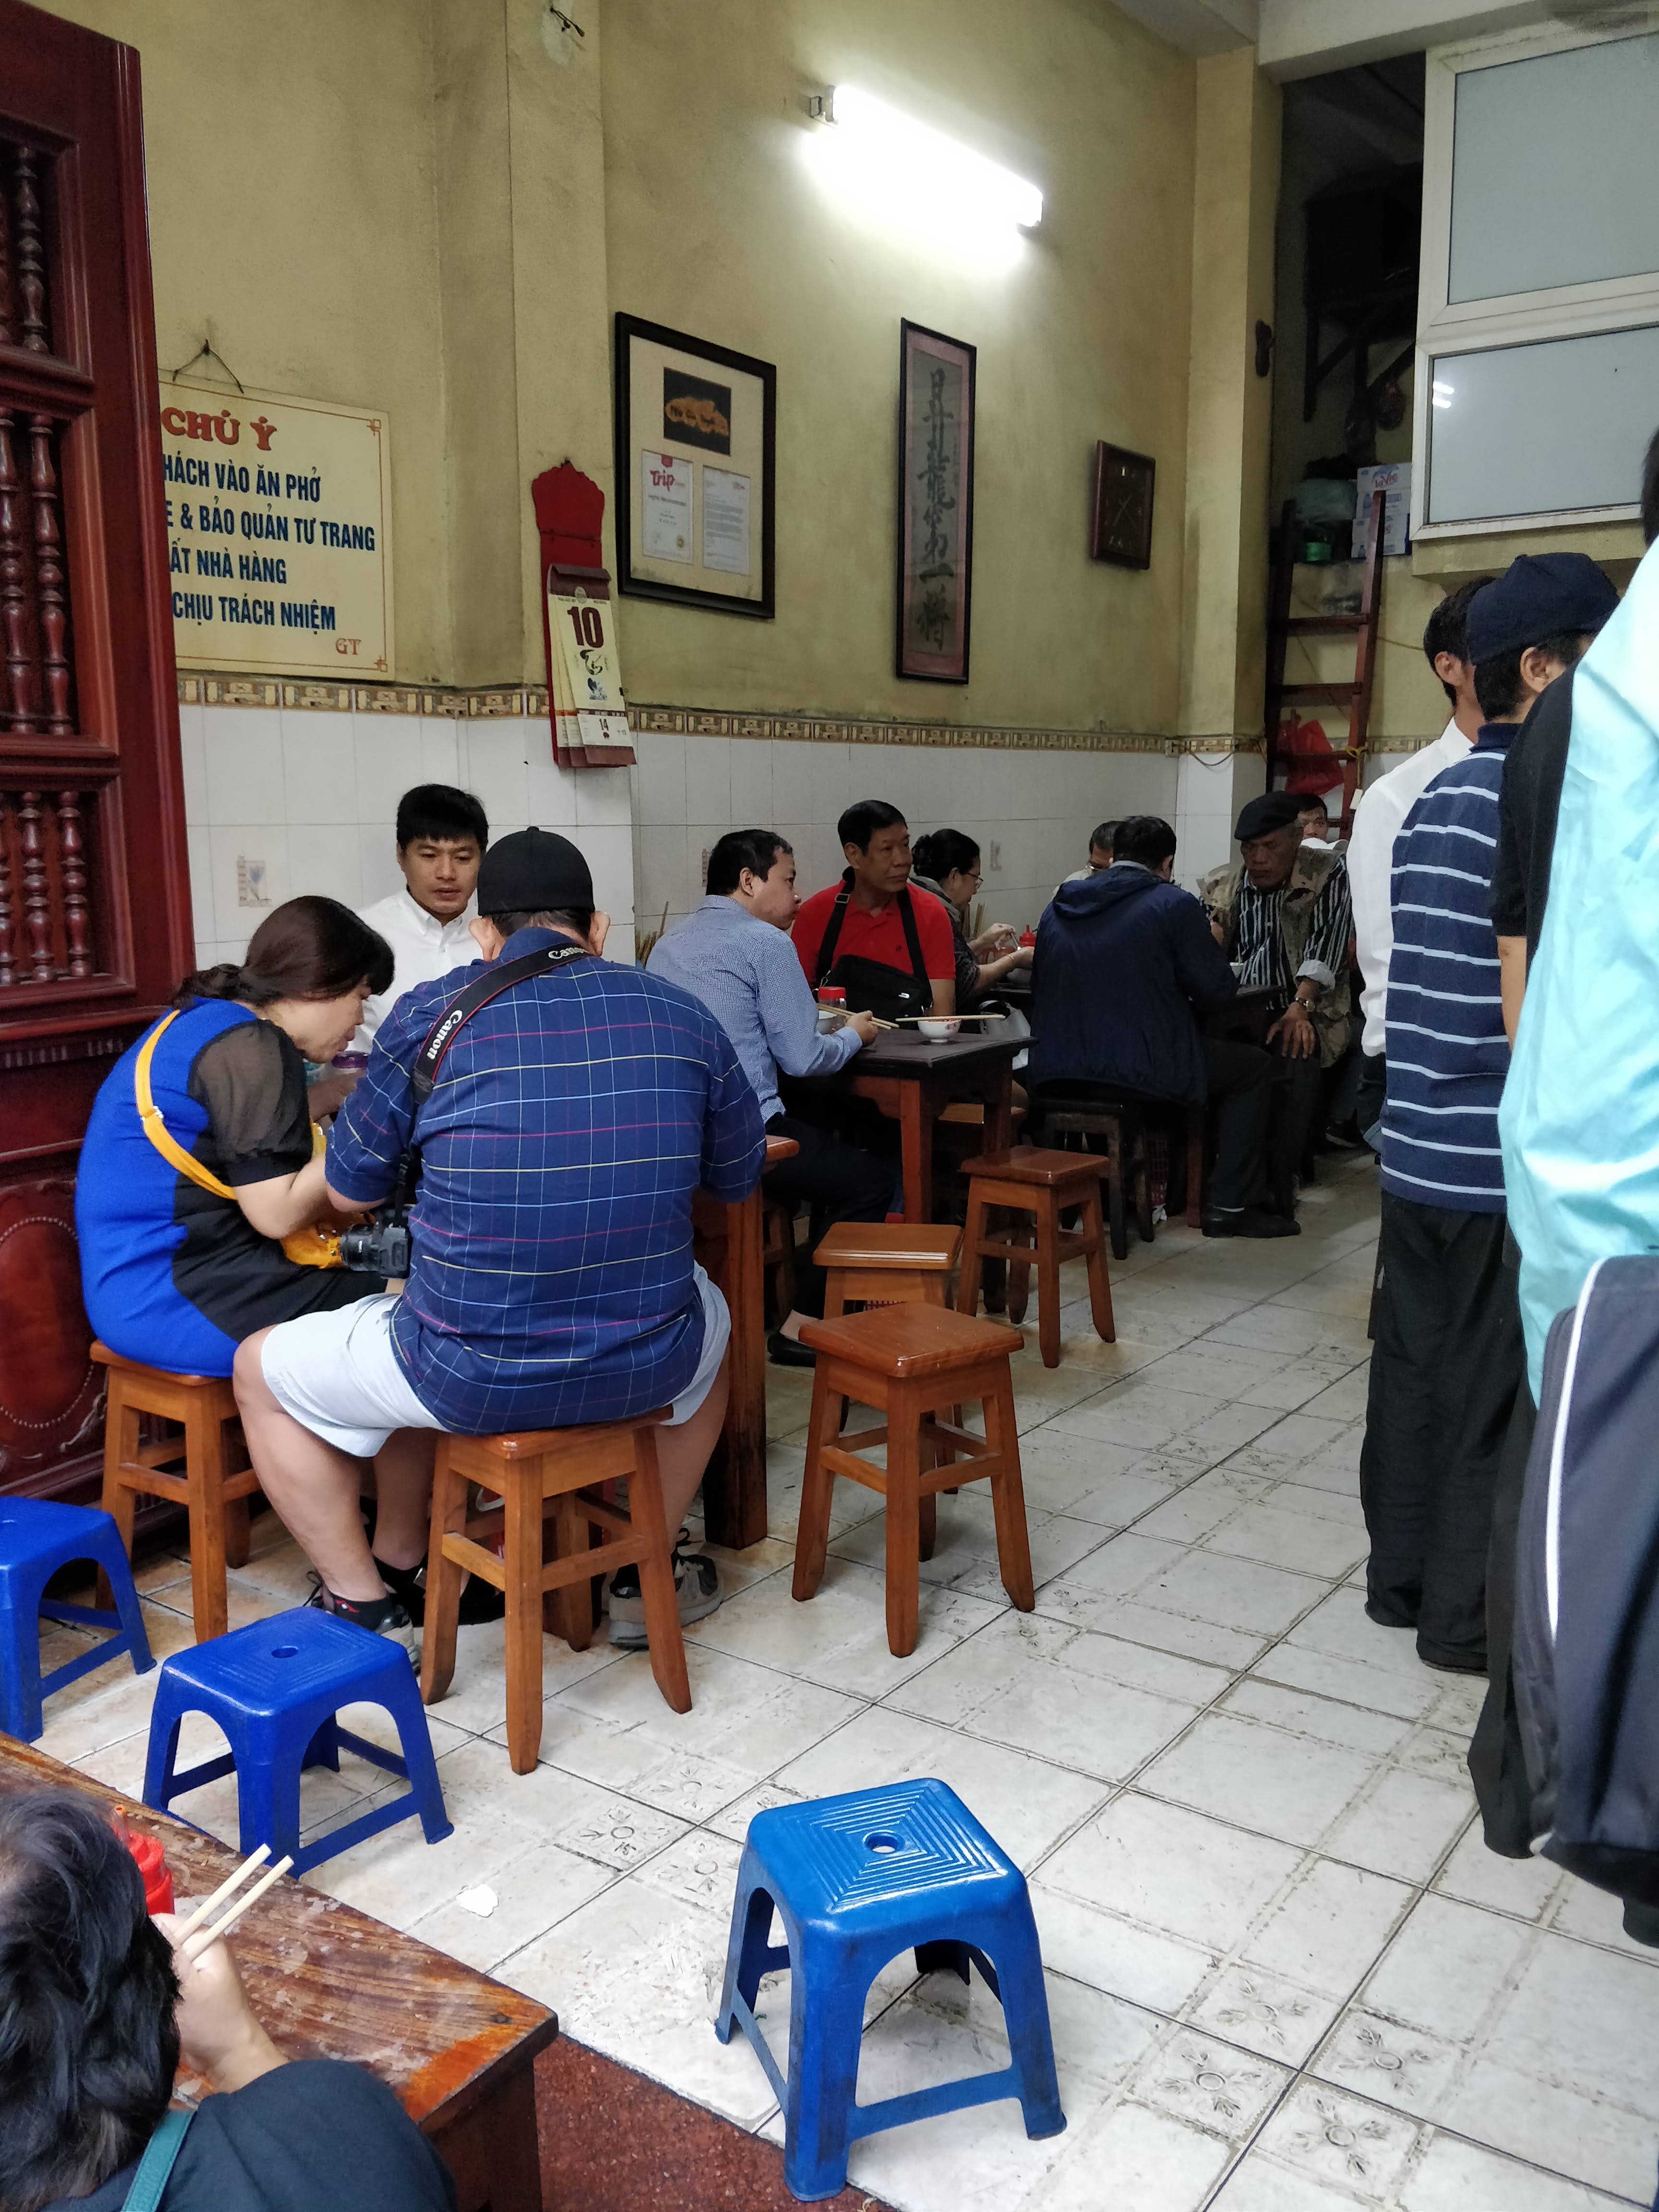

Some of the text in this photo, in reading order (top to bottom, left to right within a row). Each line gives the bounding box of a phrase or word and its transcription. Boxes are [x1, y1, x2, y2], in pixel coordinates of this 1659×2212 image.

[163, 451, 321, 503] HÁCH VÀO ĂN PHỞ
[166, 495, 375, 551] E & BẢO QUẢN TƯ TRANG
[170, 537, 287, 584] ẤT NHÀ HÀNG
[173, 591, 336, 635] CHỊU TRÁCH NHIỆM
[567, 606, 604, 648] 10
[335, 638, 361, 655] GT
[427, 1010, 463, 1060] Canon
